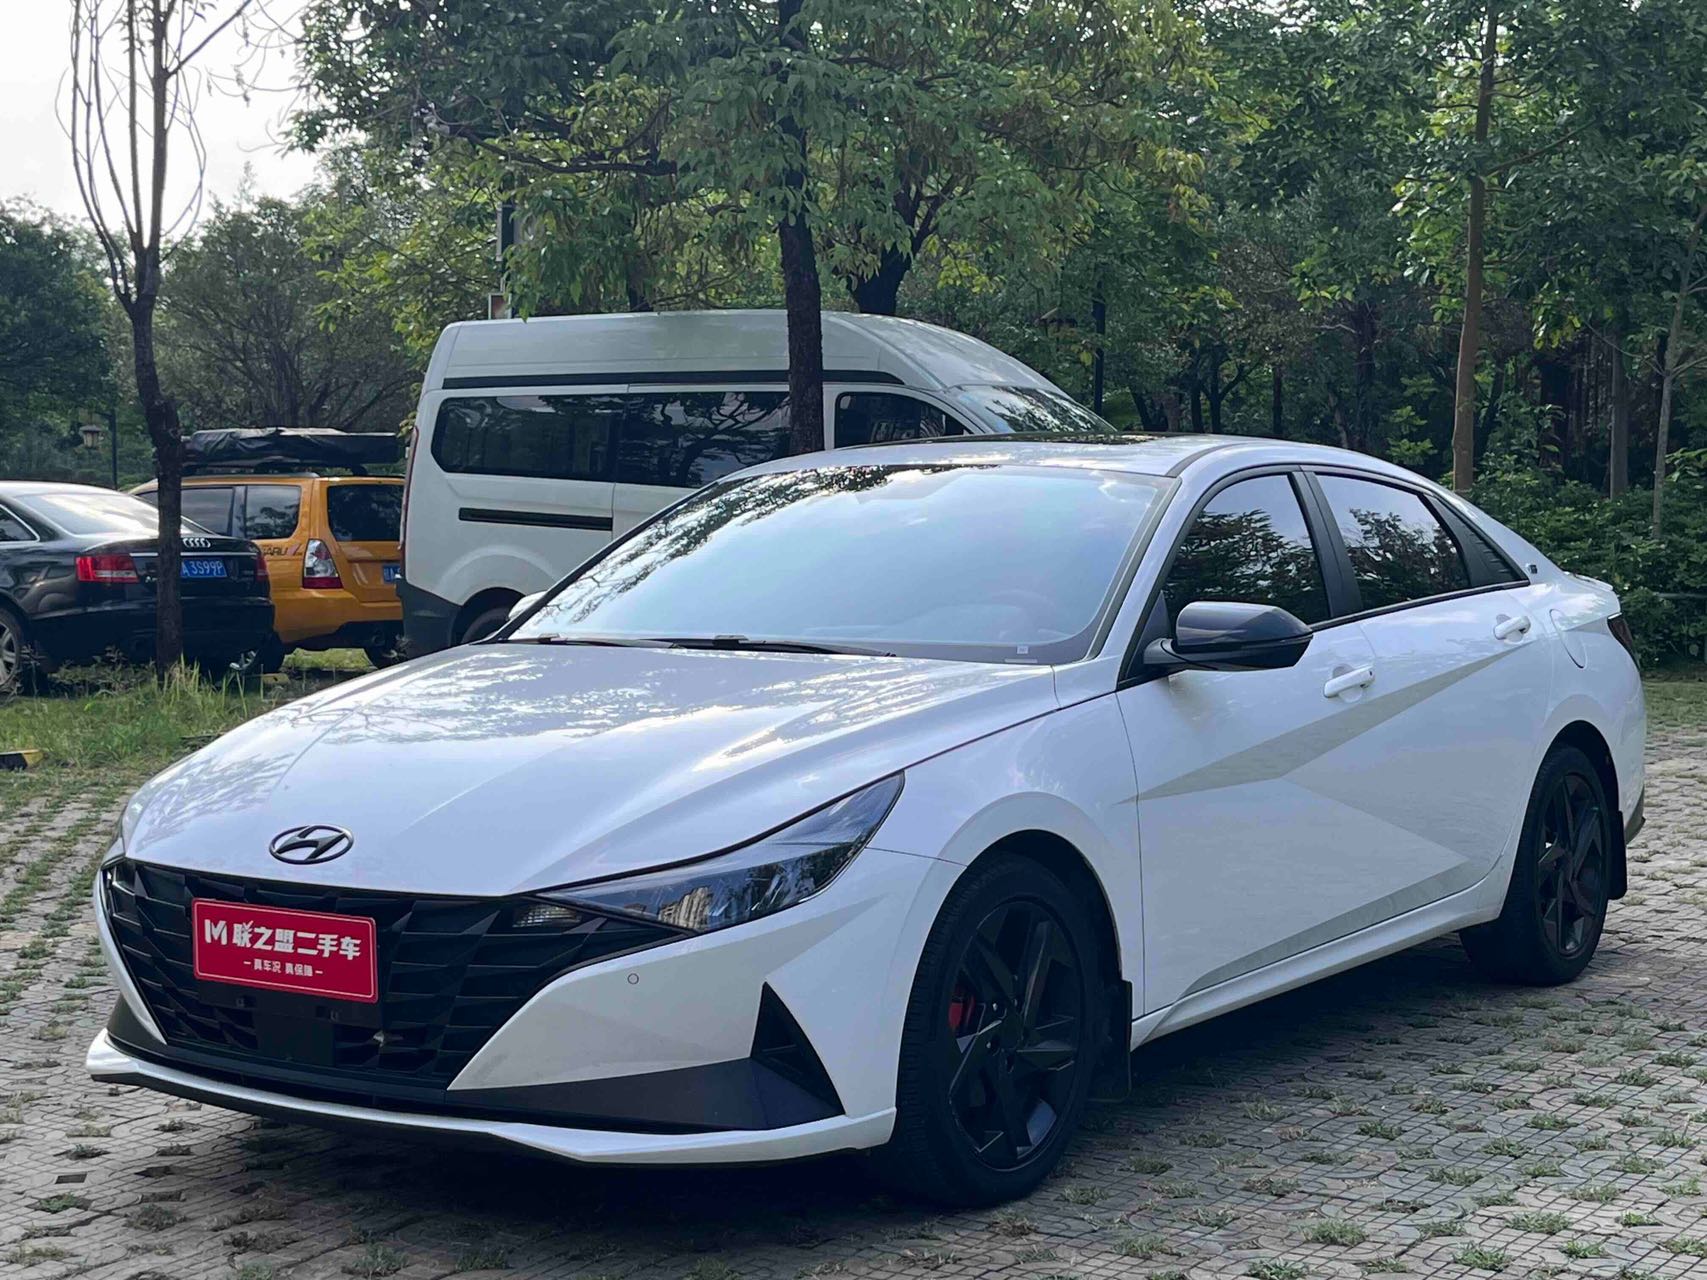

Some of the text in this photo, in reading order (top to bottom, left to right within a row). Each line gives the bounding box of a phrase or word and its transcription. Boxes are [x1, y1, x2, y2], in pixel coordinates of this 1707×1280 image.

[232, 920, 361, 960] 联之盟二手车
[253, 958, 281, 974] 真车况
